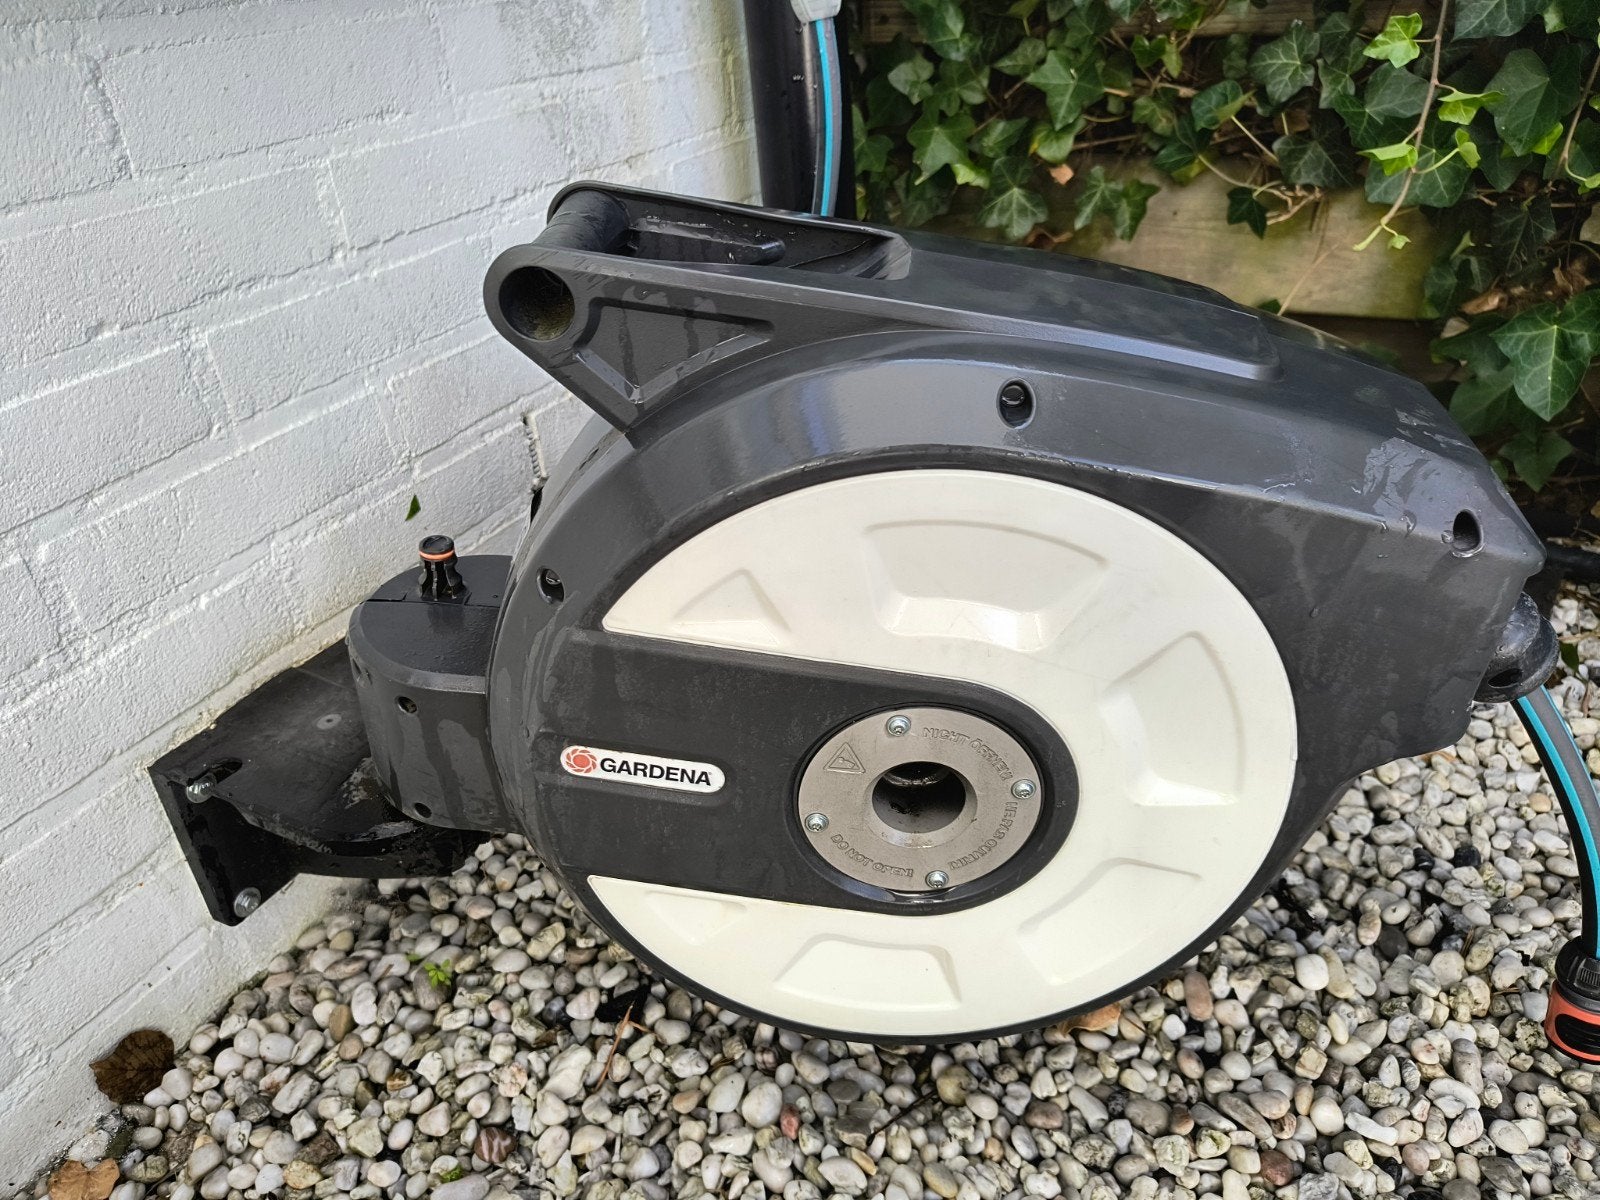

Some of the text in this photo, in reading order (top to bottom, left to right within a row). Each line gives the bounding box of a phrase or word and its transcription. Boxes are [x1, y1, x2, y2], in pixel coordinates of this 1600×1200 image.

[923, 727, 970, 745] NICHT
[600, 758, 711, 786] GARDENA
[831, 834, 914, 877] DO NOT OPEN!
